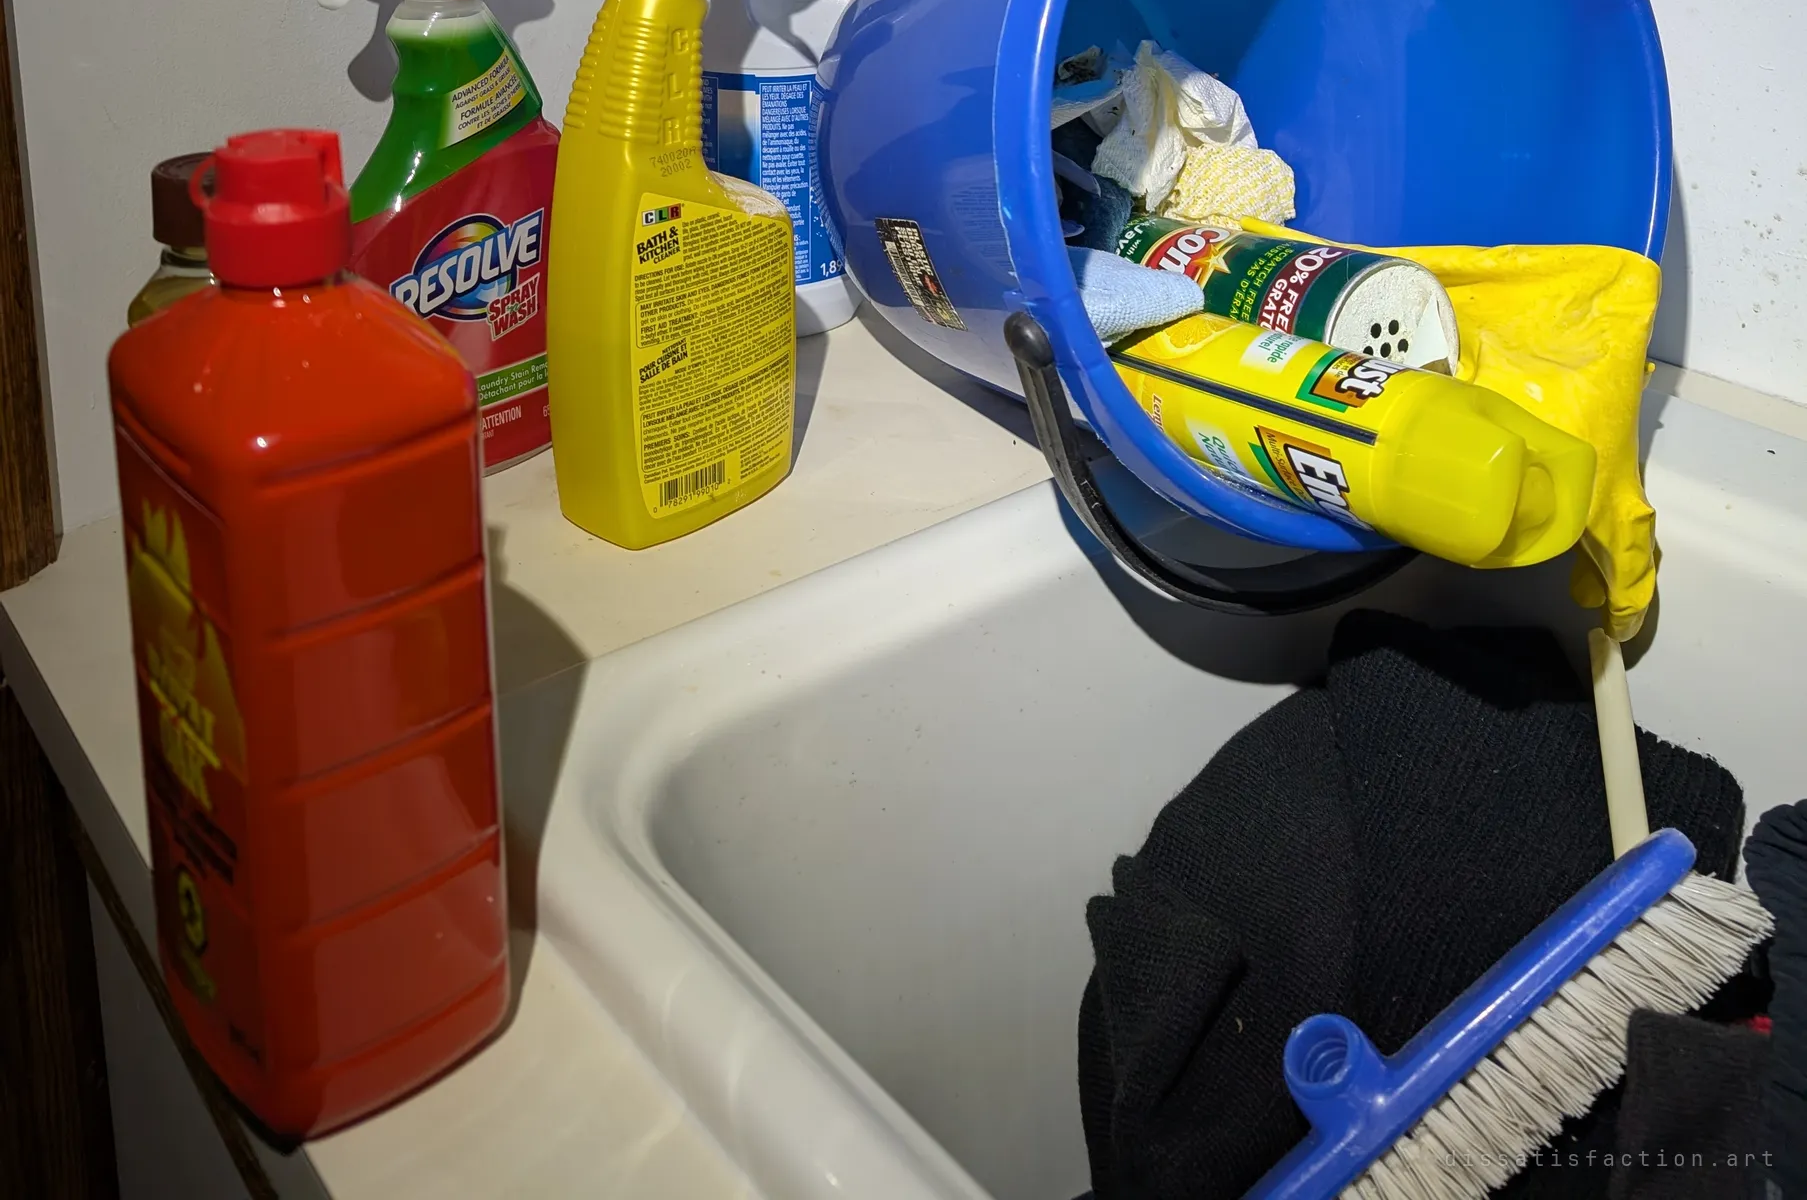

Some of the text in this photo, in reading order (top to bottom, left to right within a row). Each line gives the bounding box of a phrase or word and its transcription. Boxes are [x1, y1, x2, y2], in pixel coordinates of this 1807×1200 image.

[452, 77, 489, 103] ADVANCED
[455, 94, 478, 110] AGAINST
[480, 85, 495, 97] GRASS
[803, 83, 807, 91] ET
[460, 97, 493, 120] FORMULE
[458, 115, 480, 130] CONTRE
[477, 120, 484, 128] ET
[660, 159, 693, 178] 20002
[644, 205, 680, 224] CLR
[637, 226, 679, 255] BATH &
[639, 237, 679, 264] KITCHEN
[395, 215, 540, 314] RESOLVE
[653, 246, 681, 264] CLEANER
[635, 270, 663, 281] DIRECTIONS
[664, 266, 673, 274] FOR
[1247, 259, 1265, 278] PAS
[1241, 248, 1294, 320] SCRATCH FREE
[488, 279, 538, 338] SPRAY WASH
[640, 324, 656, 334] FIRST
[658, 321, 667, 330] AID
[639, 342, 687, 376] POUR CUISINE ET
[1267, 340, 1293, 363] rapide
[511, 369, 529, 380] Stain
[640, 350, 688, 383] SALLE DE BAIN
[479, 372, 543, 400] Détachant pour la
[482, 405, 521, 430] ATTENTION
[643, 417, 665, 428] LORSQUE
[644, 437, 671, 451] PREMIERS
[668, 493, 693, 508] 78291
[696, 482, 719, 498] 99010
